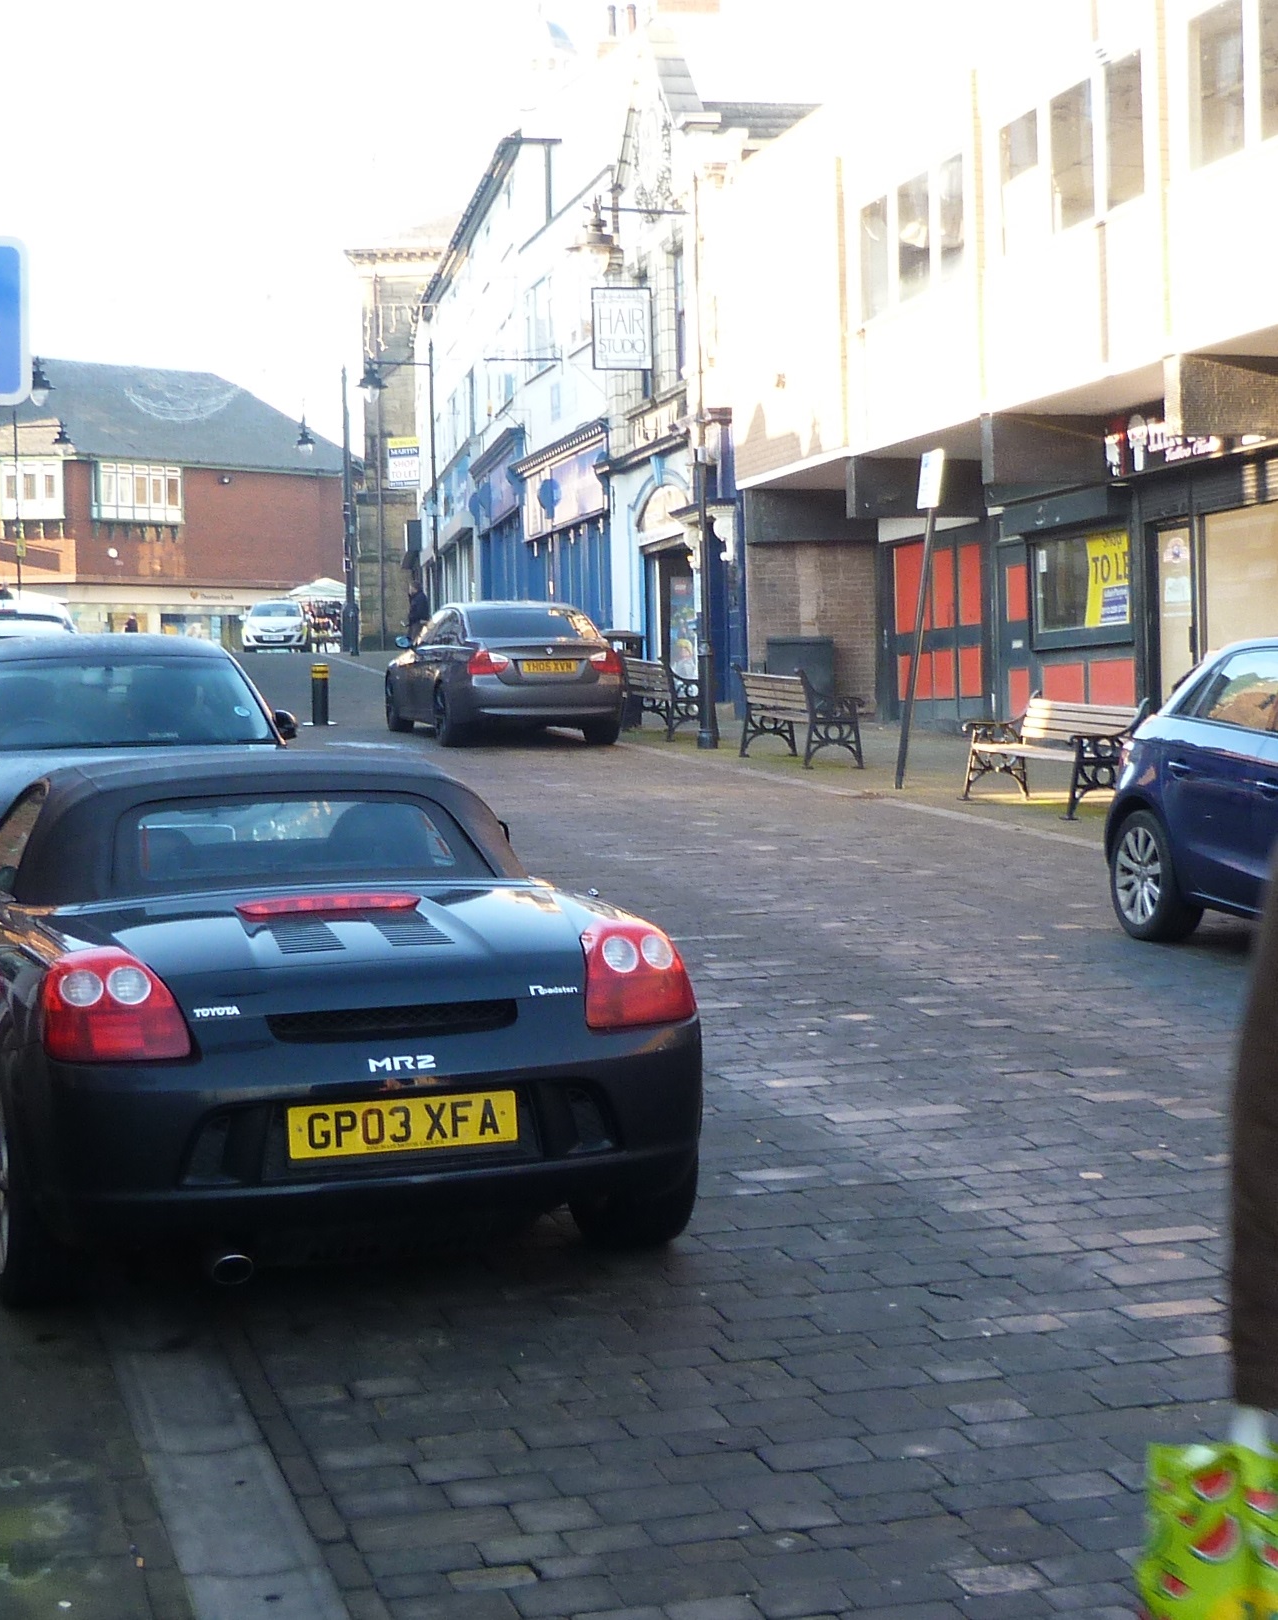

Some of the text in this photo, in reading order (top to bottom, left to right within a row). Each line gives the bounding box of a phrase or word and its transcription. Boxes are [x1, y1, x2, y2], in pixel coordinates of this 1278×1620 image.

[598, 308, 645, 335] HAIR
[598, 338, 647, 354] STUDIO
[393, 459, 416, 468] SHOP
[391, 469, 418, 479] TO LET
[1091, 551, 1129, 585] TO LE
[193, 1005, 242, 1018] TOYOTA
[368, 1053, 437, 1073] MR2
[307, 1099, 500, 1150] GP03 XFA
